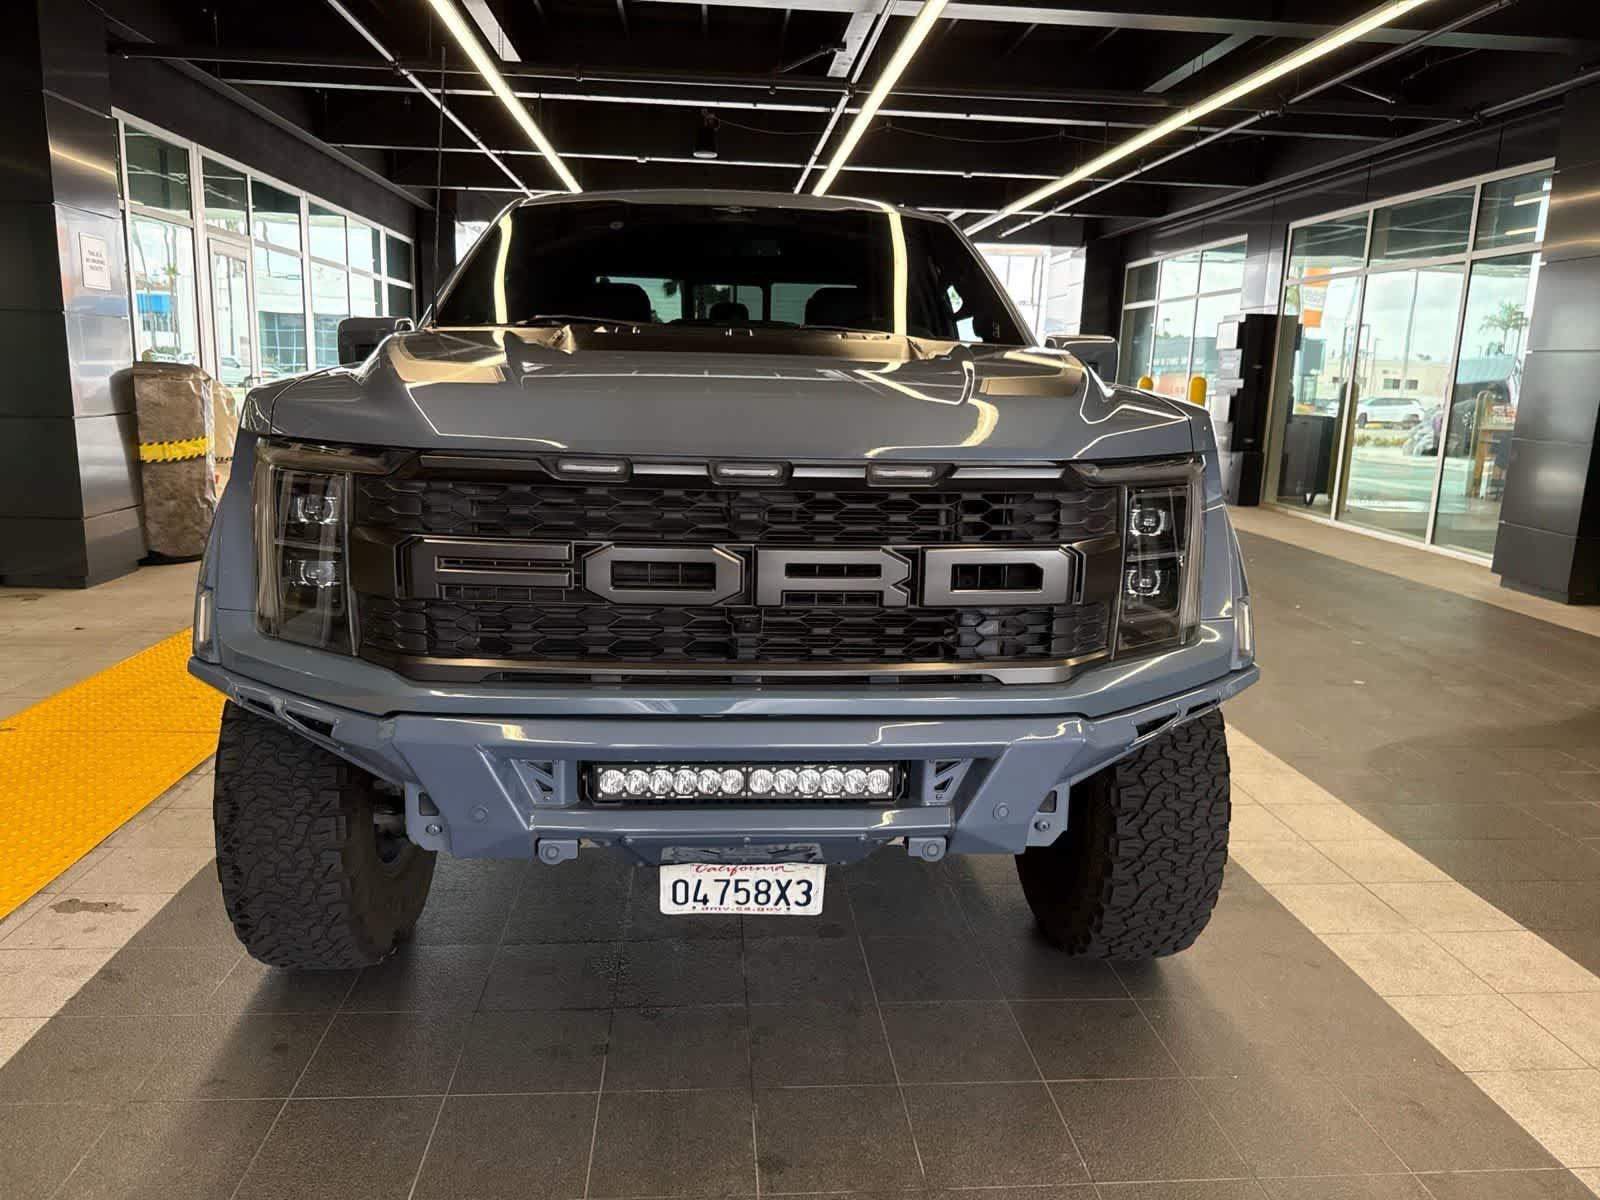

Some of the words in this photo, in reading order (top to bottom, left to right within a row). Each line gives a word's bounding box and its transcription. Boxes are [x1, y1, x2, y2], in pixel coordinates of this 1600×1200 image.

[397, 534, 1077, 607] FORD
[695, 864, 795, 876] California
[671, 878, 813, 906] 04758X3
